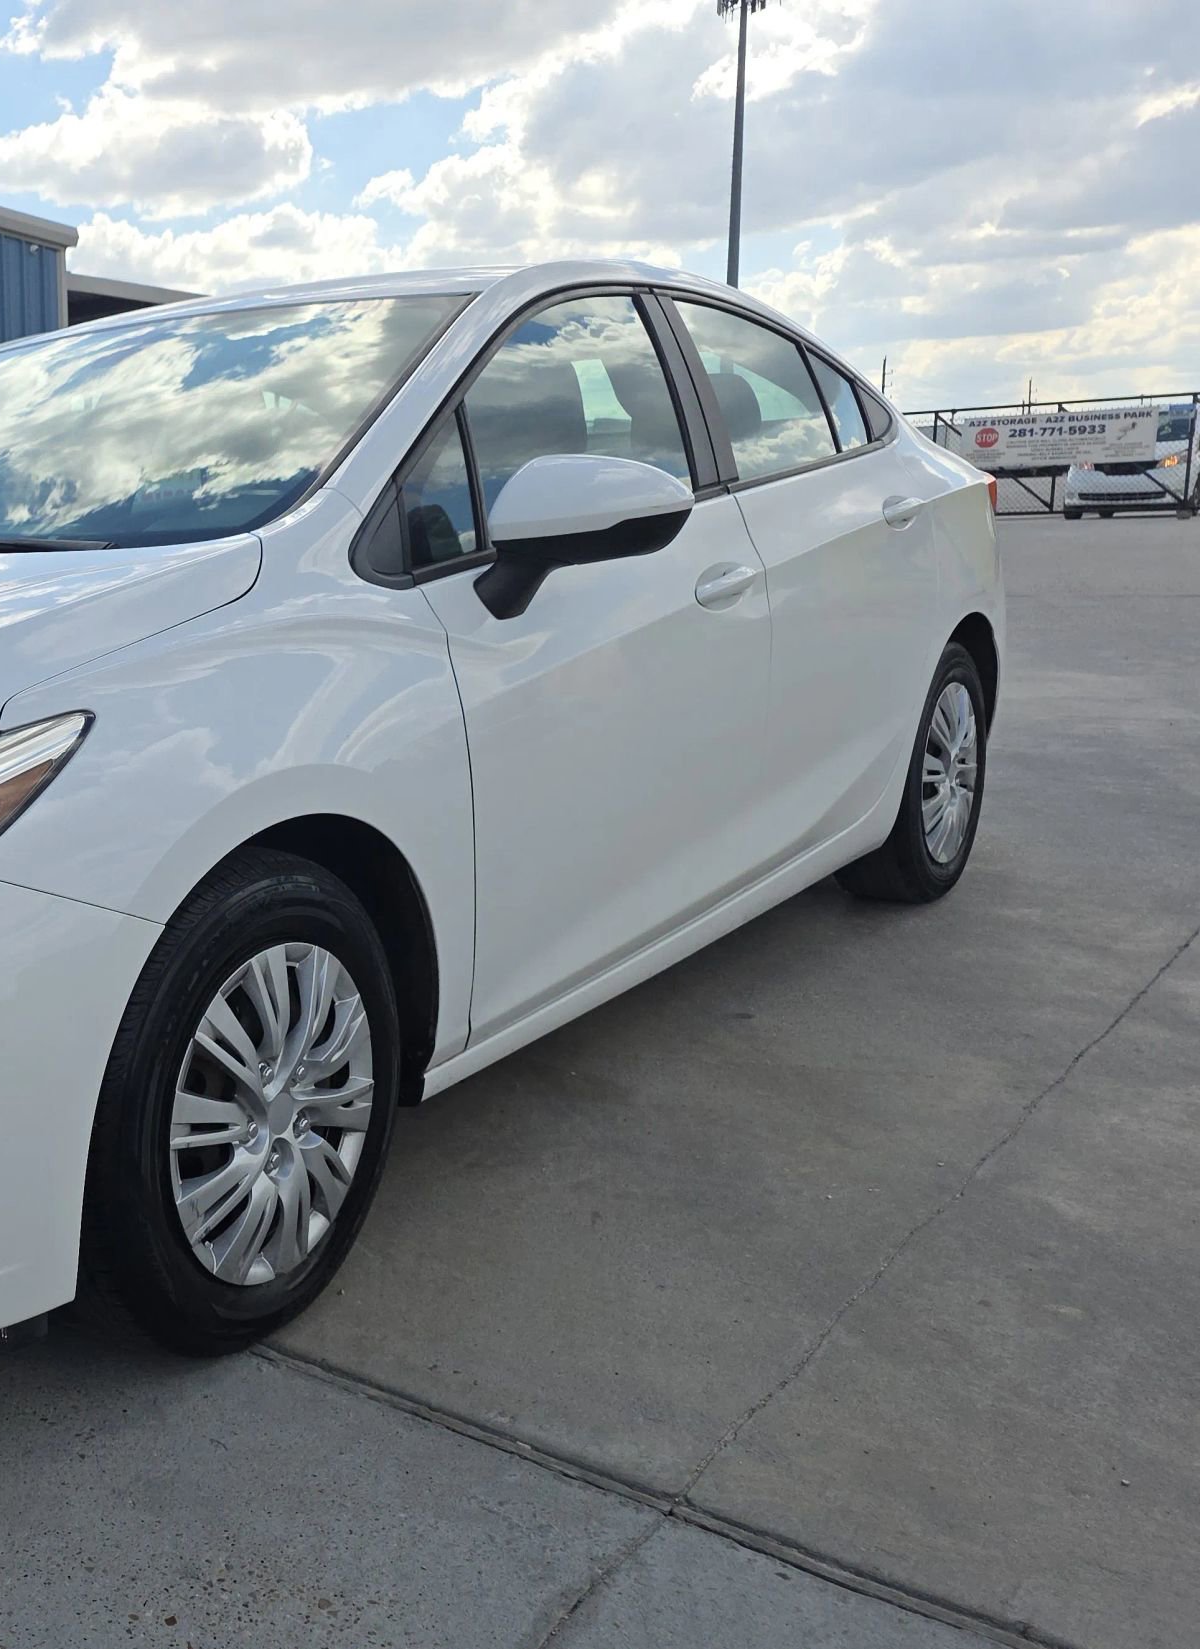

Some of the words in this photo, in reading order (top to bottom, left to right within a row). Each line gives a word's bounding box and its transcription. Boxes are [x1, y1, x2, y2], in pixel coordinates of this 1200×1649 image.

[990, 417, 1037, 426] STORAGE
[1045, 416, 1065, 424] A2Z
[1068, 413, 1121, 422] BUSINESS
[1124, 410, 1153, 419] PARK
[976, 432, 998, 443] STOP
[1007, 424, 1106, 438] 281-771-5933
